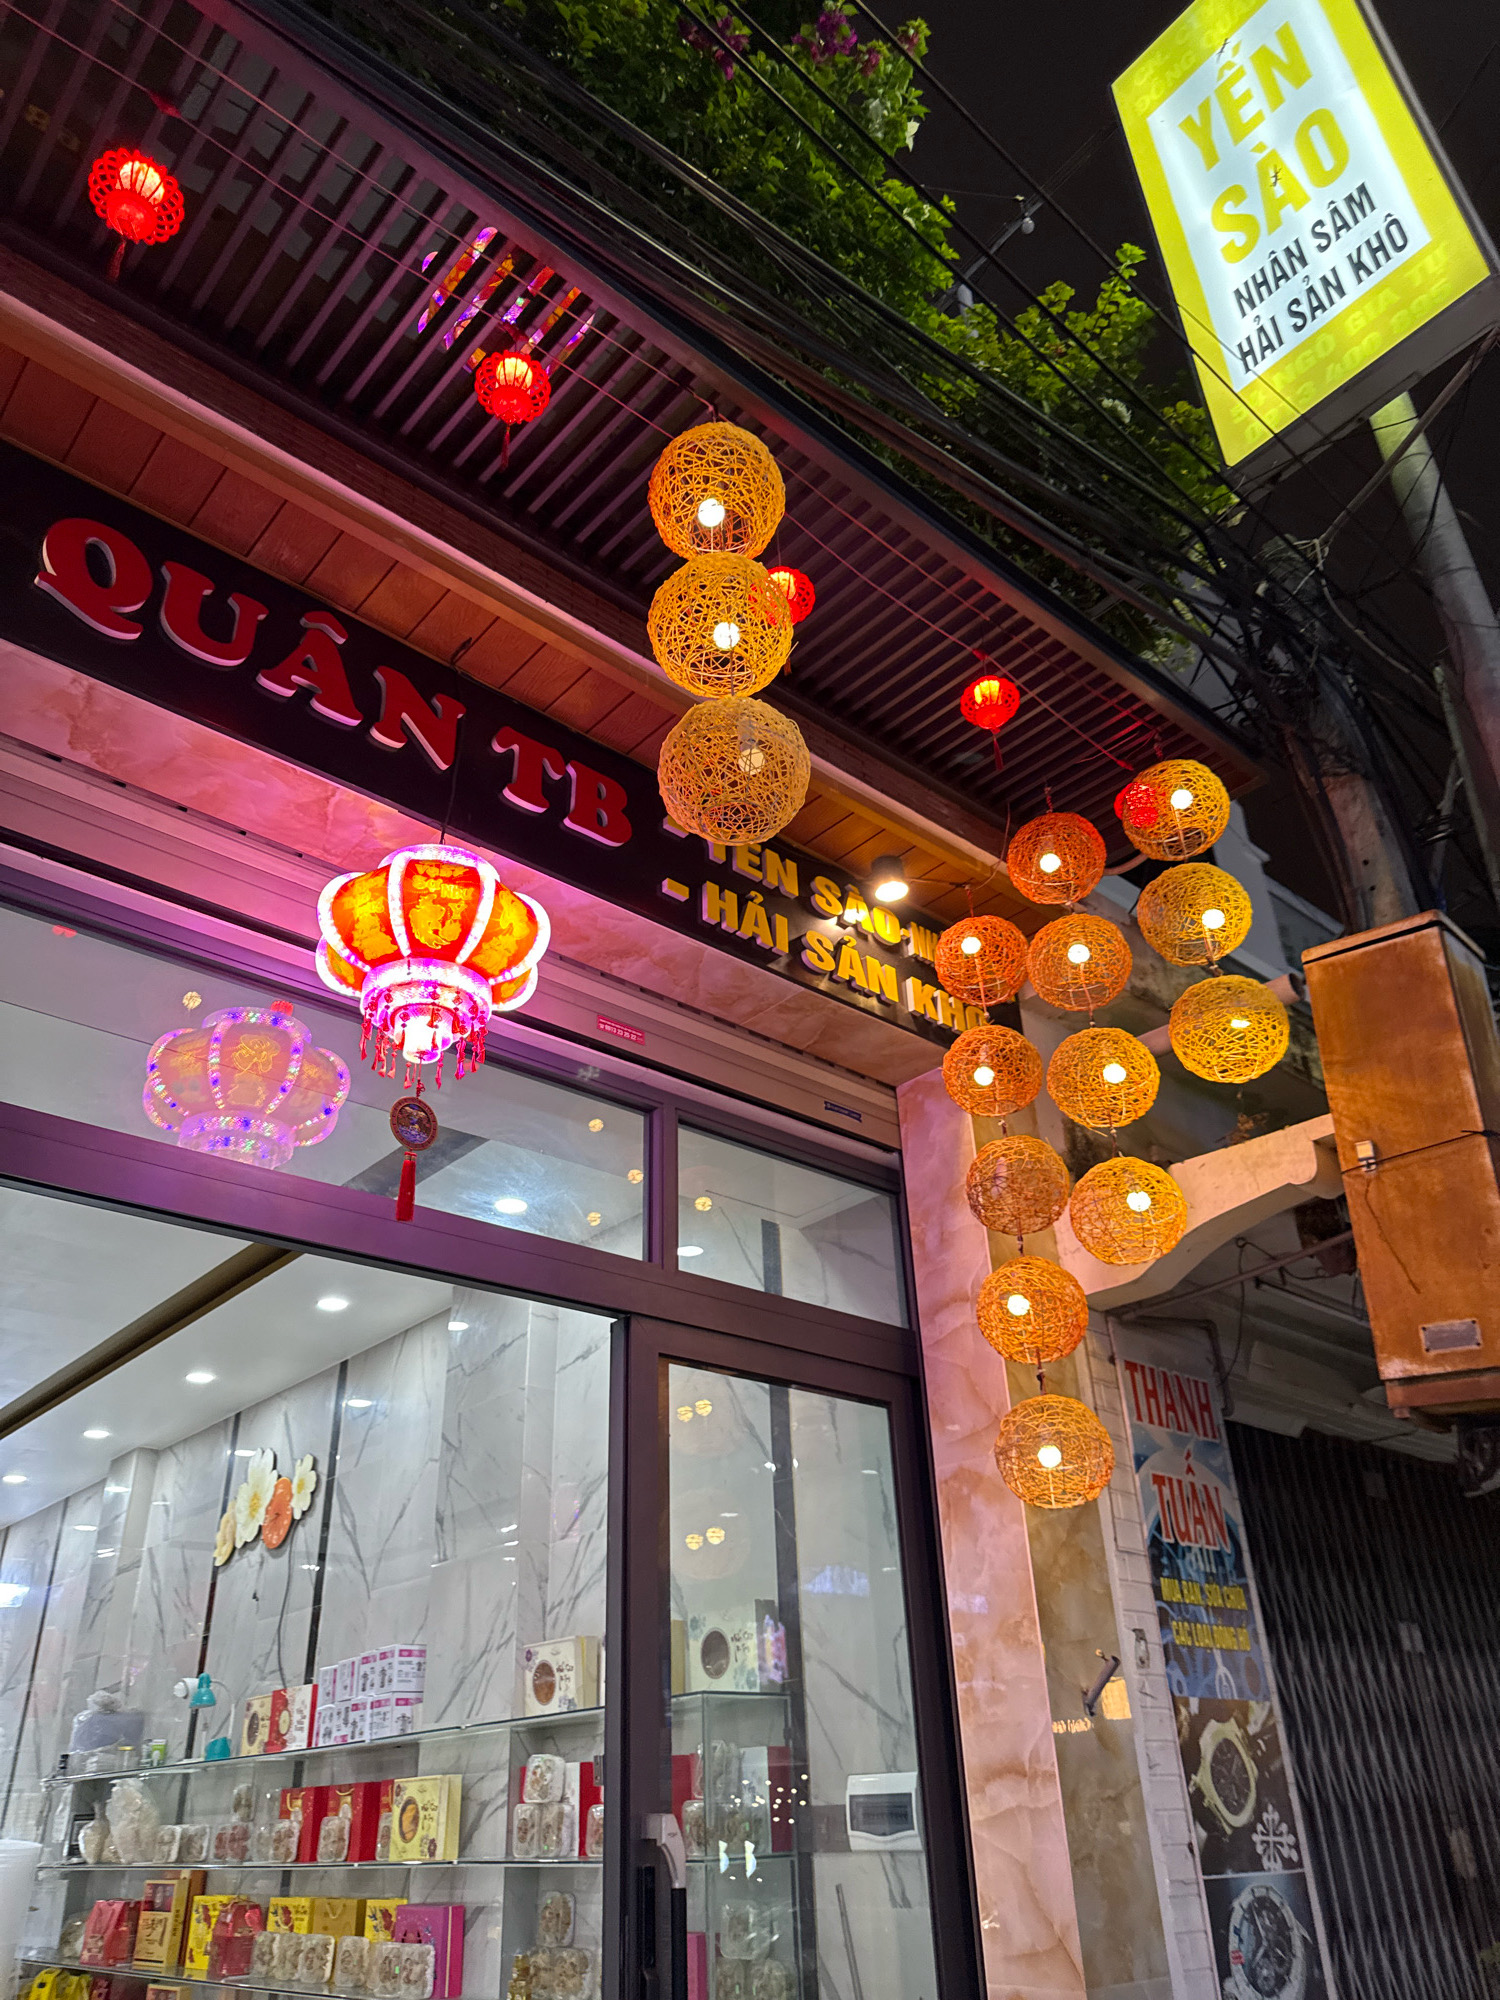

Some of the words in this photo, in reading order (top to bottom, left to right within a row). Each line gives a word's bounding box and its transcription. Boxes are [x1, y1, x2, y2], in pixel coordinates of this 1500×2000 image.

[1178, 21, 1313, 171] YẾN
[1211, 108, 1350, 264] SÀO
[1232, 245, 1309, 319] NHÂN
[1310, 181, 1377, 252] SÂM
[1235, 316, 1286, 375] HẢI
[1291, 277, 1347, 333] SẢN
[1352, 213, 1409, 287] KHÔ
[34, 517, 467, 771] QUÂN
[491, 725, 633, 848] TB
[702, 879, 790, 956] HẢI
[800, 930, 900, 1004] SẢN
[1124, 1360, 1220, 1442] THANH
[1151, 1448, 1230, 1551] TUẤN
